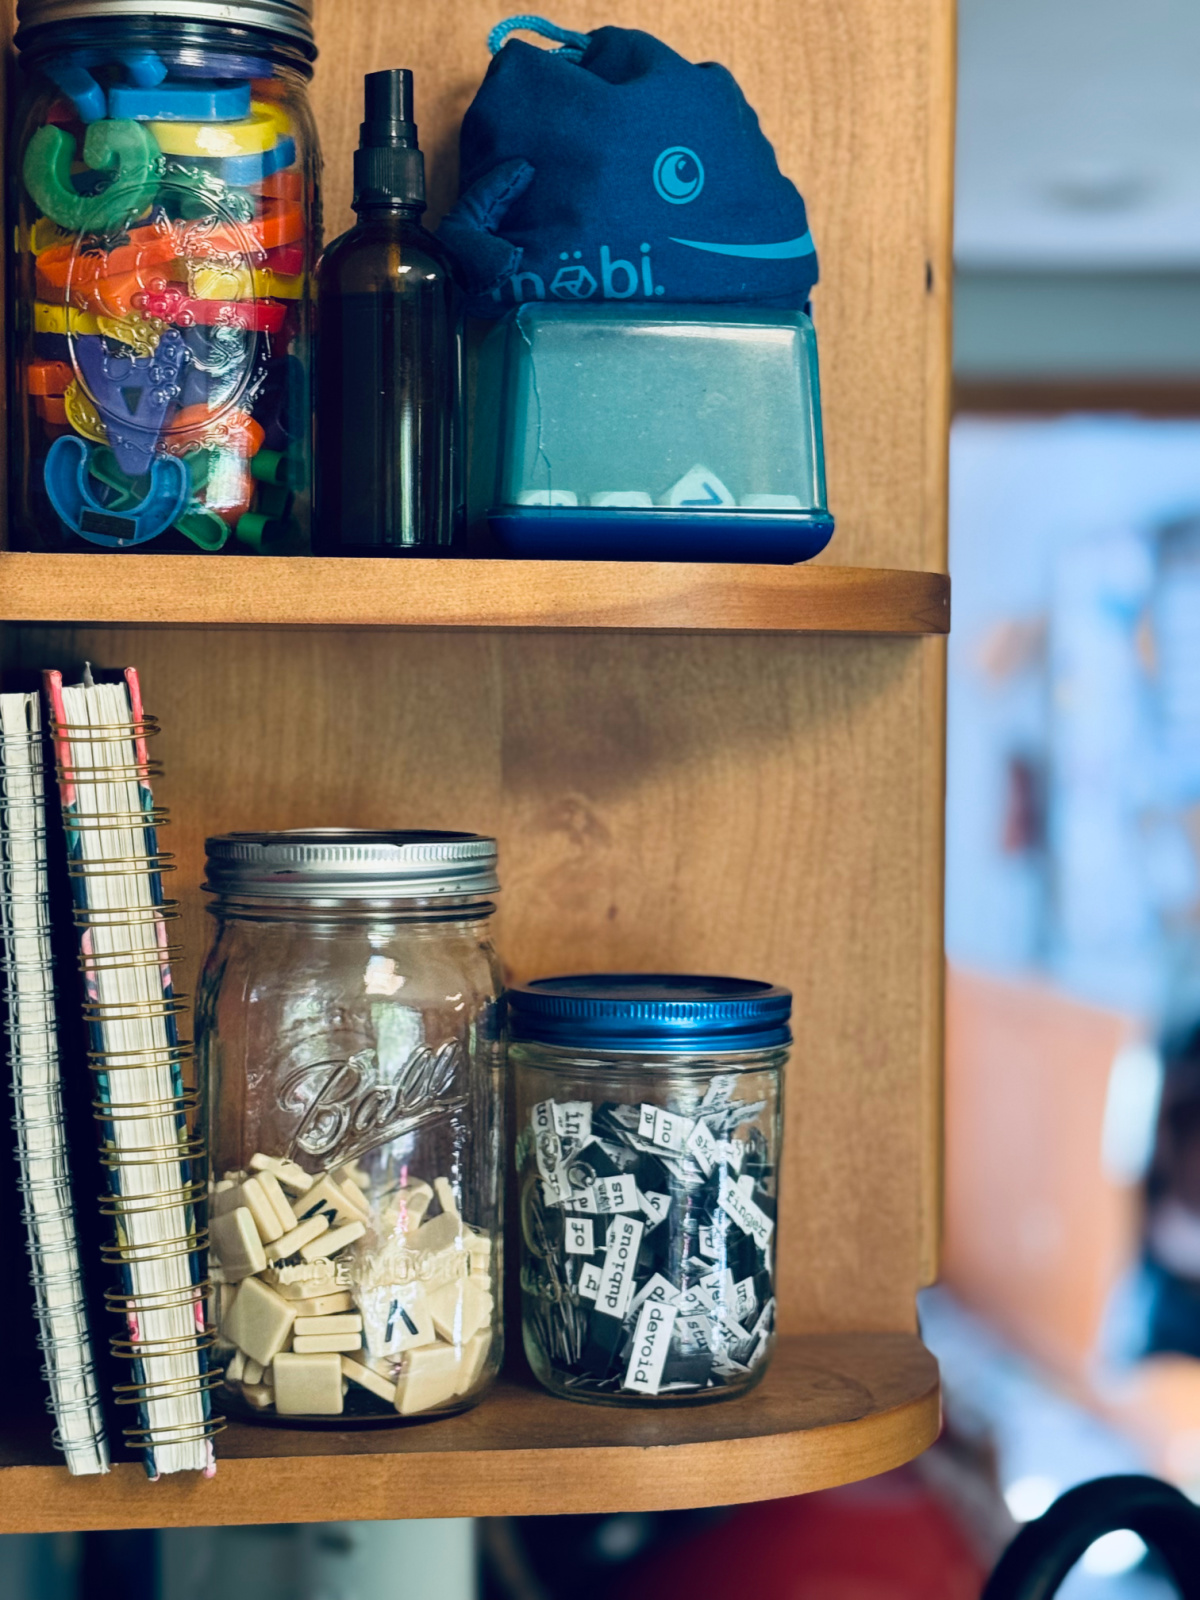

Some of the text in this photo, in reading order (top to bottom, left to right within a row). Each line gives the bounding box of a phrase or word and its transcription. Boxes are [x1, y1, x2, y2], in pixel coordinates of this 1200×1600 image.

[277, 1037, 472, 1168] Ball
[611, 1180, 625, 1207] us
[571, 1221, 586, 1247] of
[605, 1223, 634, 1309] dubious
[633, 1307, 665, 1385] devoid
